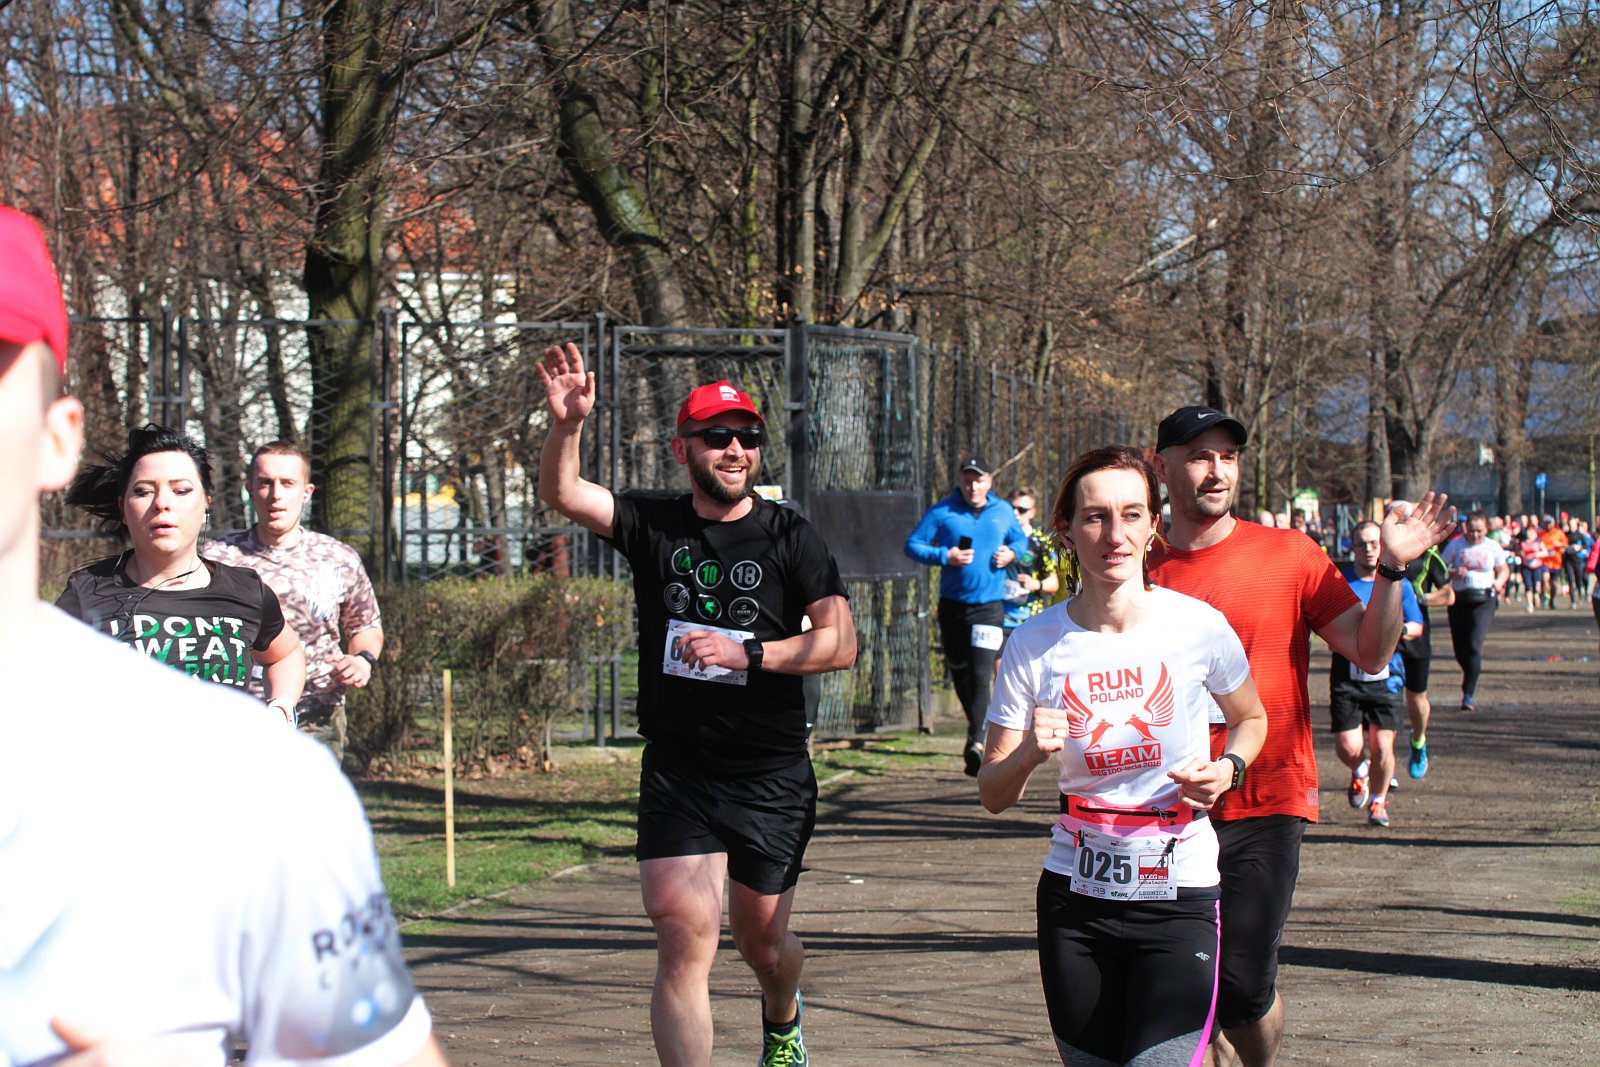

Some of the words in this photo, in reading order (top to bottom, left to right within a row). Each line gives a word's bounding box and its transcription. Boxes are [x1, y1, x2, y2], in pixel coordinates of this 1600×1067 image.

[702, 564, 718, 585] 10
[736, 566, 757, 585] 18
[110, 619, 119, 636] I
[133, 614, 244, 638] DON'T
[1087, 666, 1143, 692] RUN
[1090, 687, 1144, 705] POLAND
[1085, 744, 1161, 769] TEAM
[1090, 769, 1107, 777] BIEG
[1142, 760, 1162, 769] 2018
[1078, 846, 1132, 885] 025
